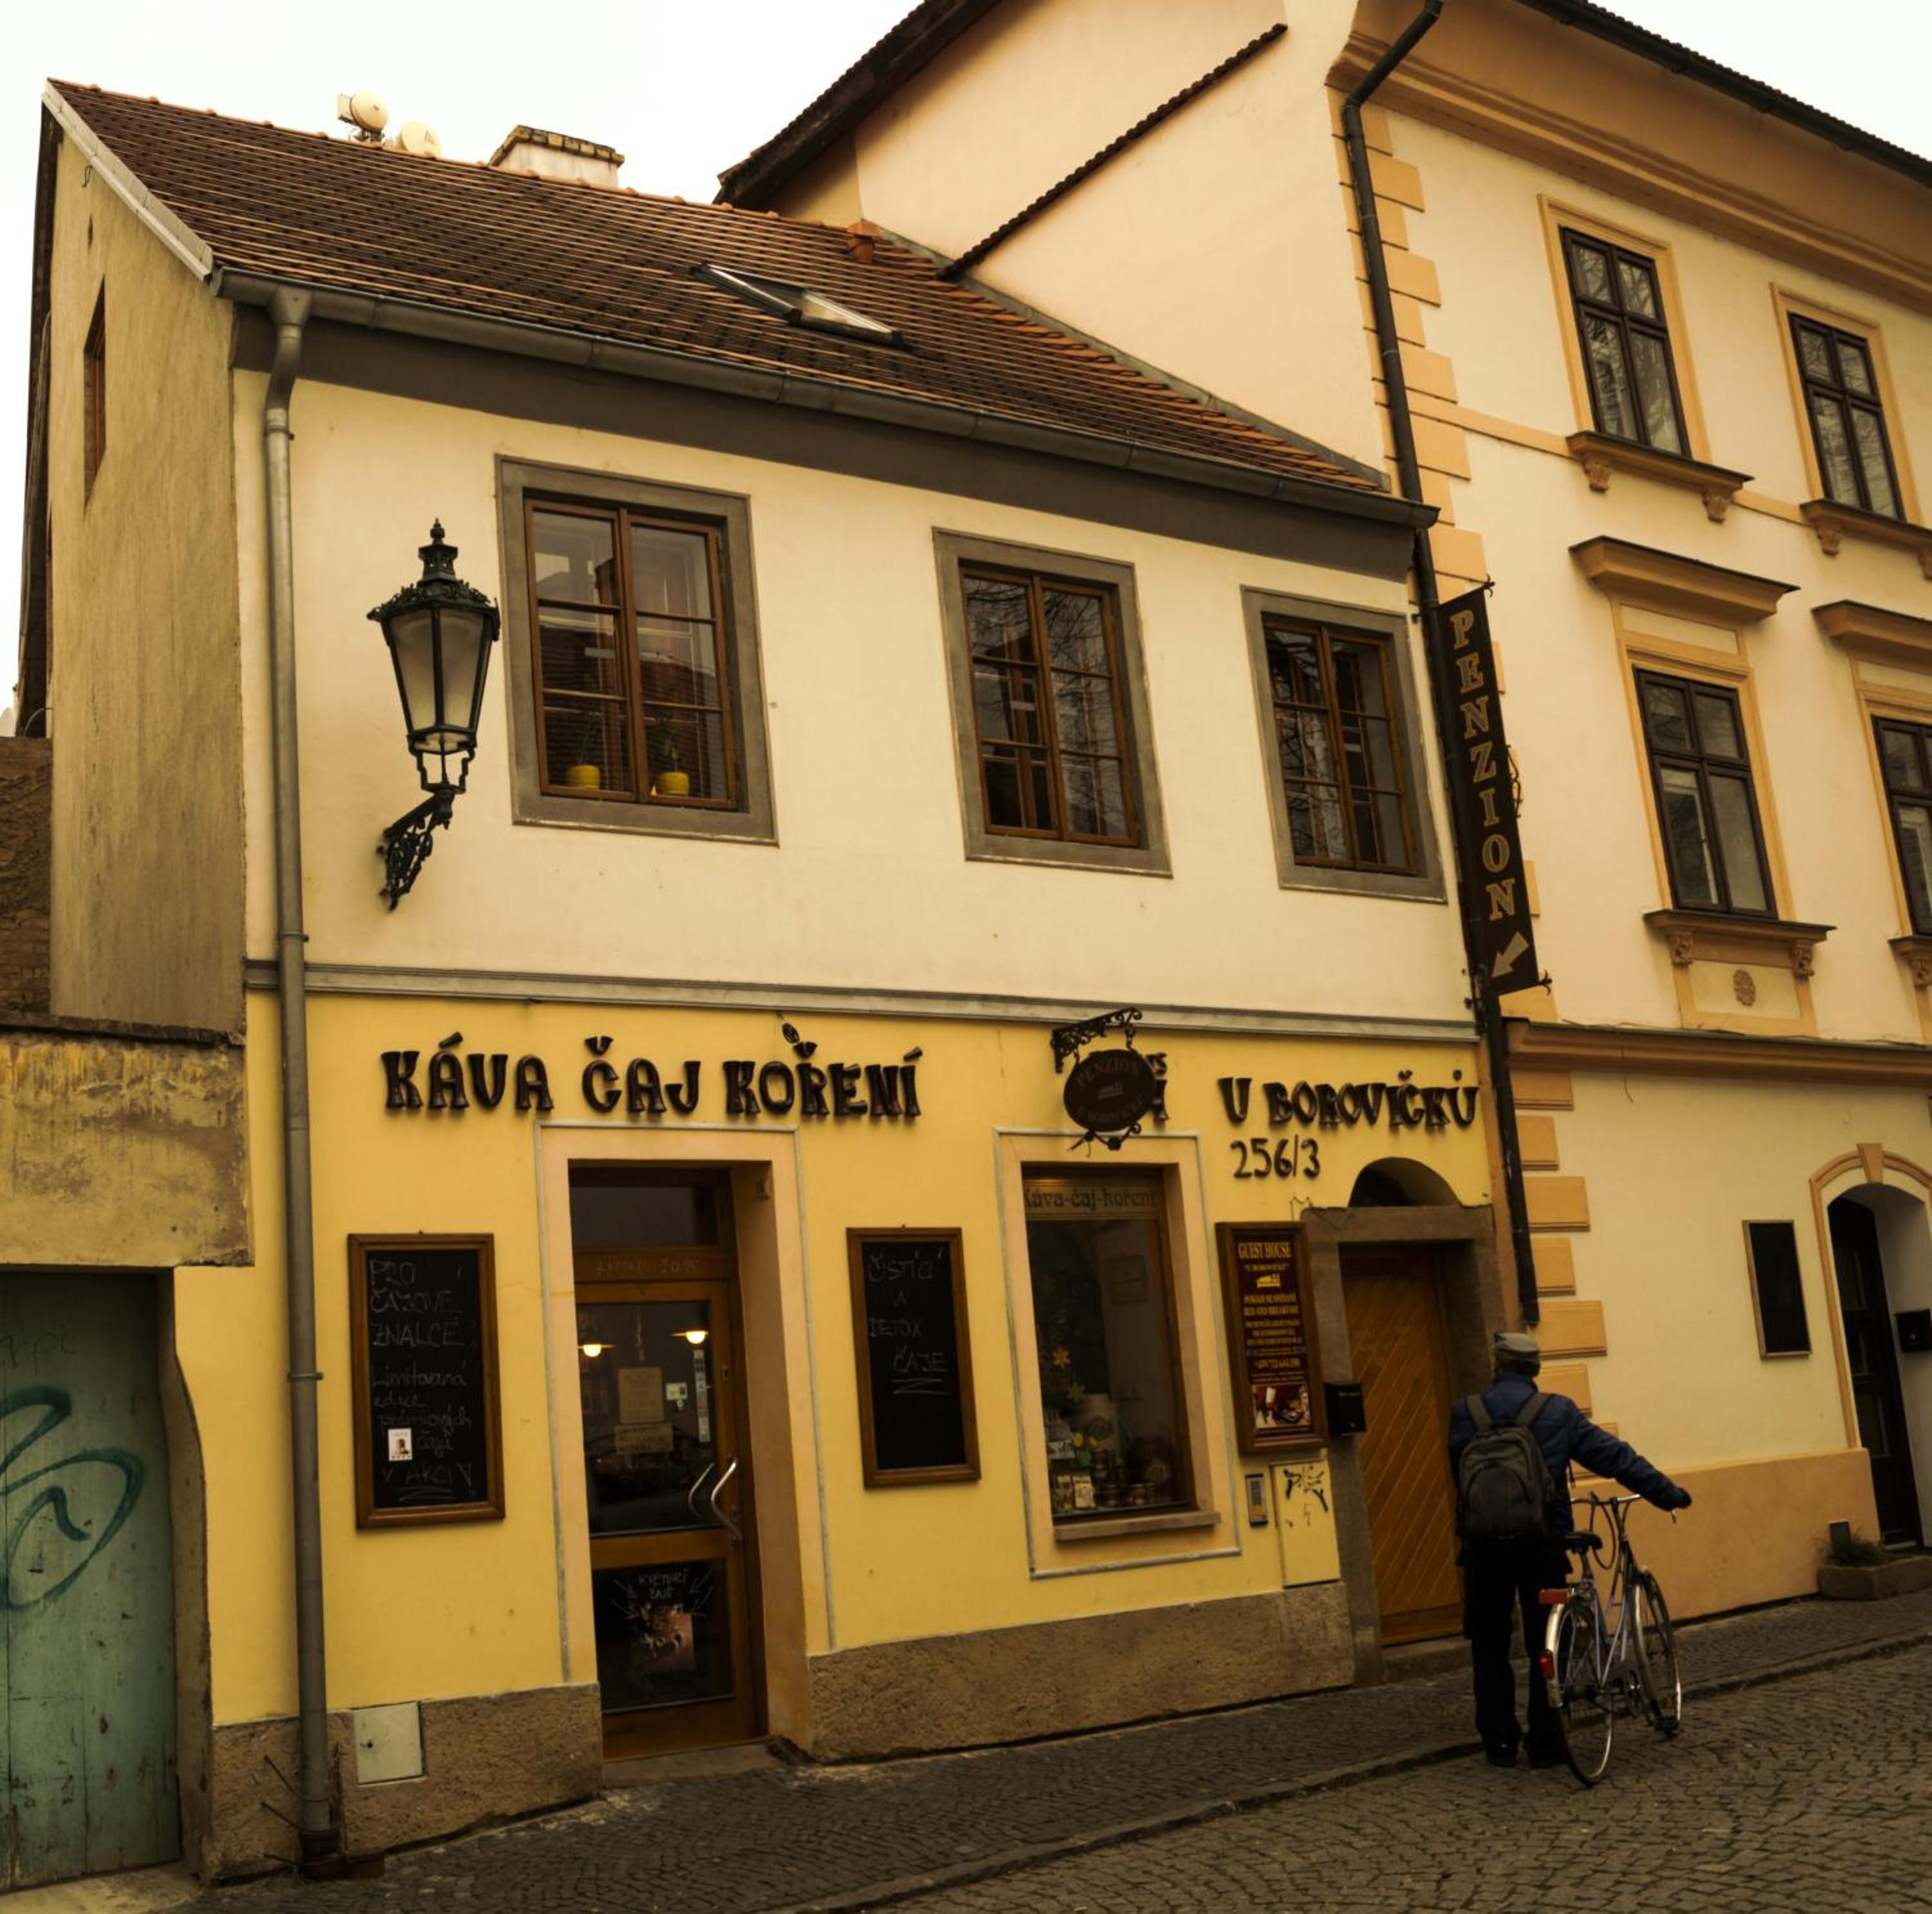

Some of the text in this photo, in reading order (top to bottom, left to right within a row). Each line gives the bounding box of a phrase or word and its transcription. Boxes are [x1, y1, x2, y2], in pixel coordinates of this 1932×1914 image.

[1450, 609, 1515, 921] PENZION
[381, 1031, 922, 1117] KÁVA ČAJ KOŘENÍ
[1218, 1077, 1252, 1124] U
[1231, 1135, 1321, 1179] 256/3
